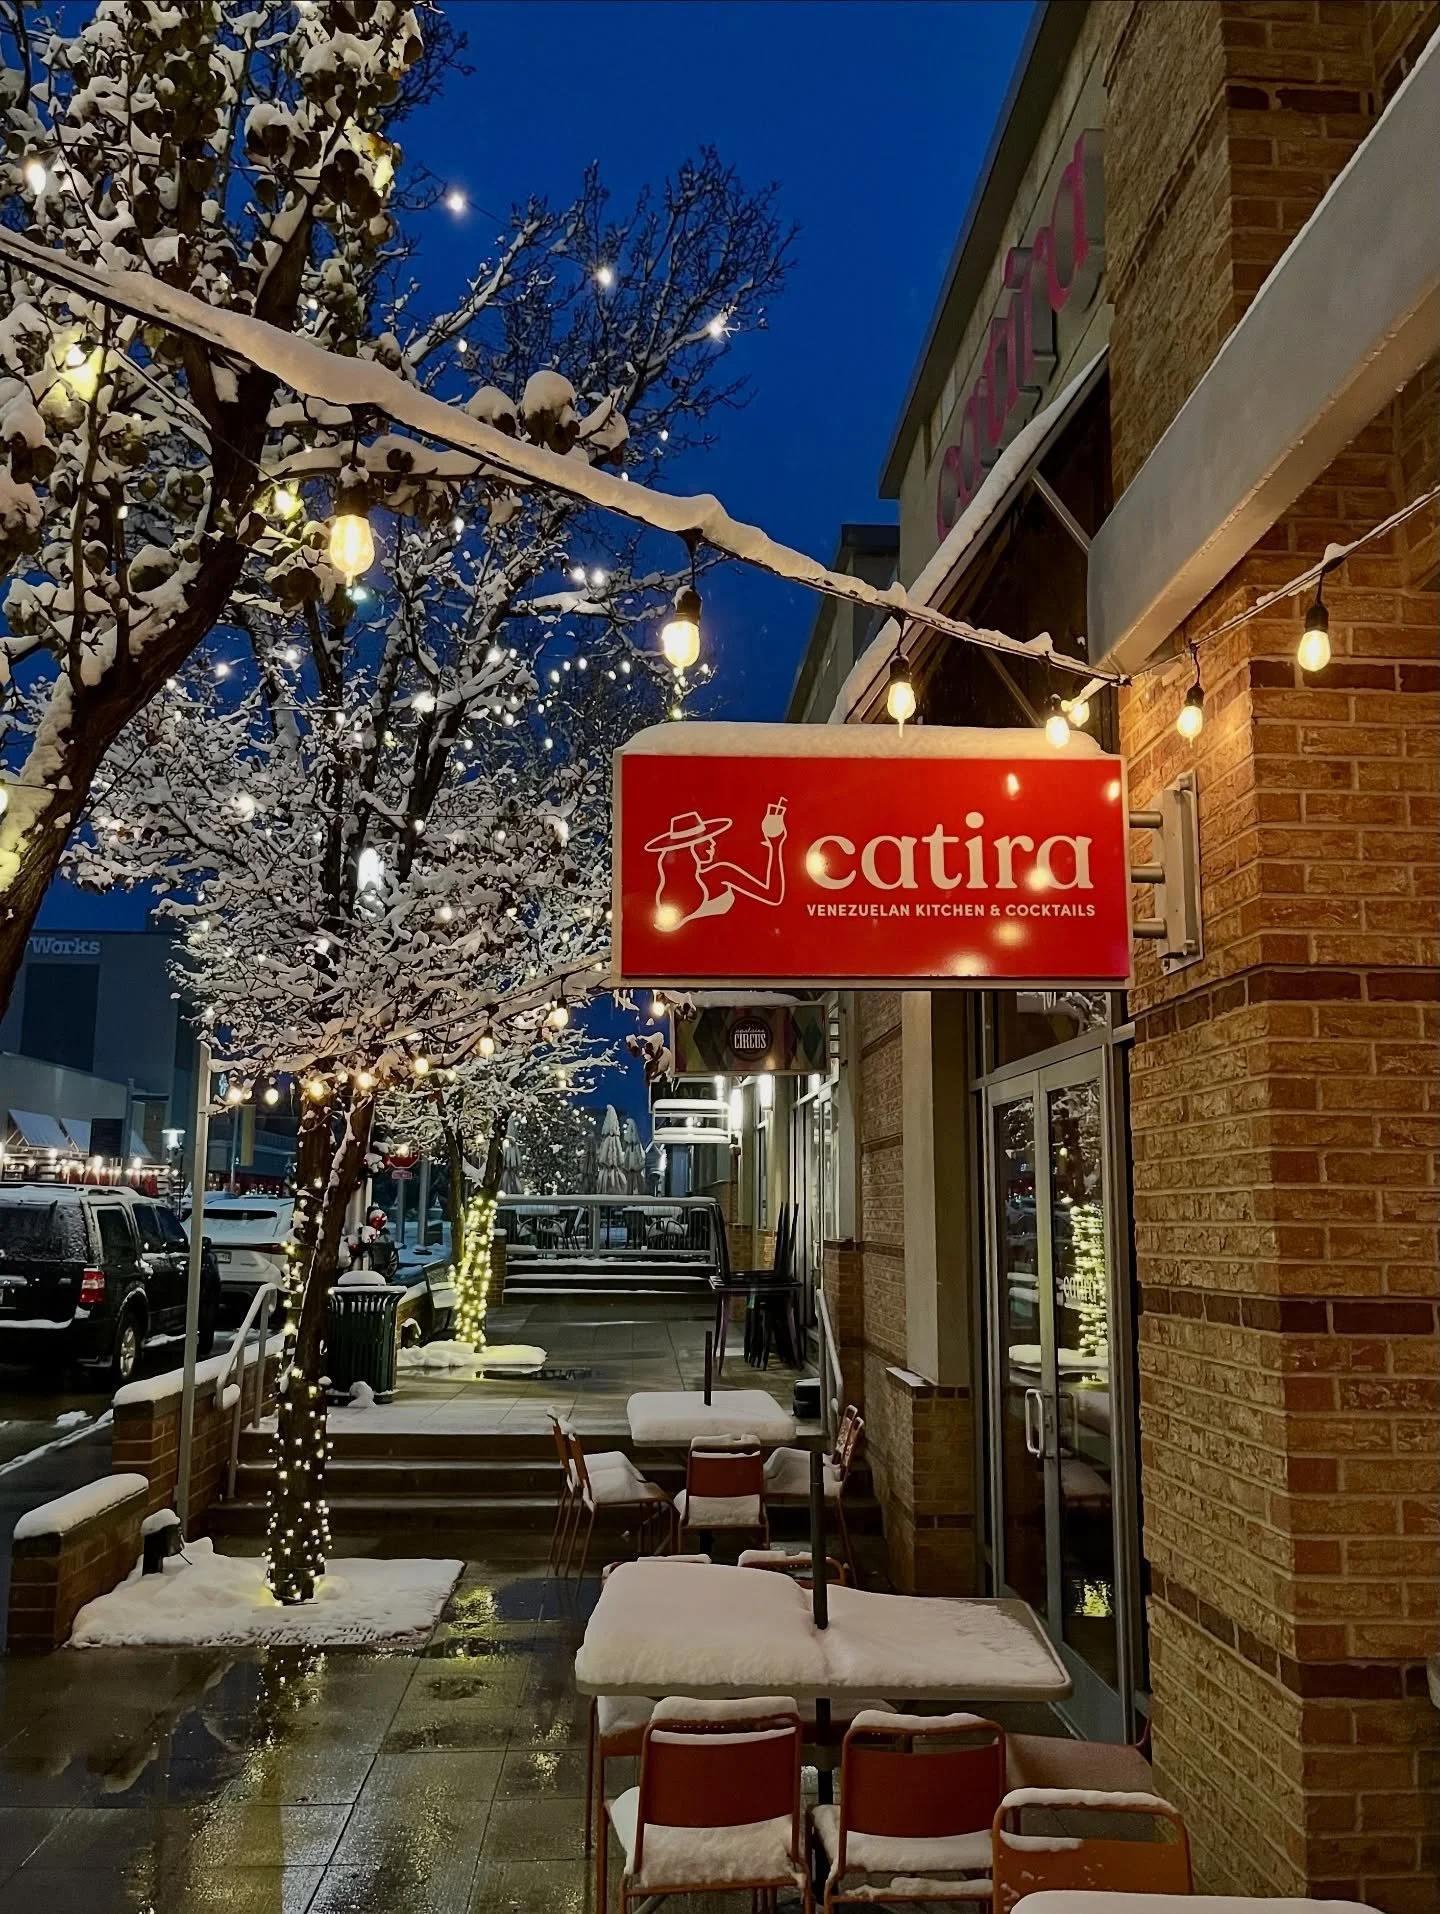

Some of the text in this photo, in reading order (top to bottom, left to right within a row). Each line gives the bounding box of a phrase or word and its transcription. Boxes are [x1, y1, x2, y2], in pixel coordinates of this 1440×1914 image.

[806, 811, 1093, 890] catira
[807, 904, 1096, 917] VENEZUELAN KITCHEN & COCKTAILS
[27, 937, 101, 955] Works
[734, 1033, 767, 1048] CIRCUS
